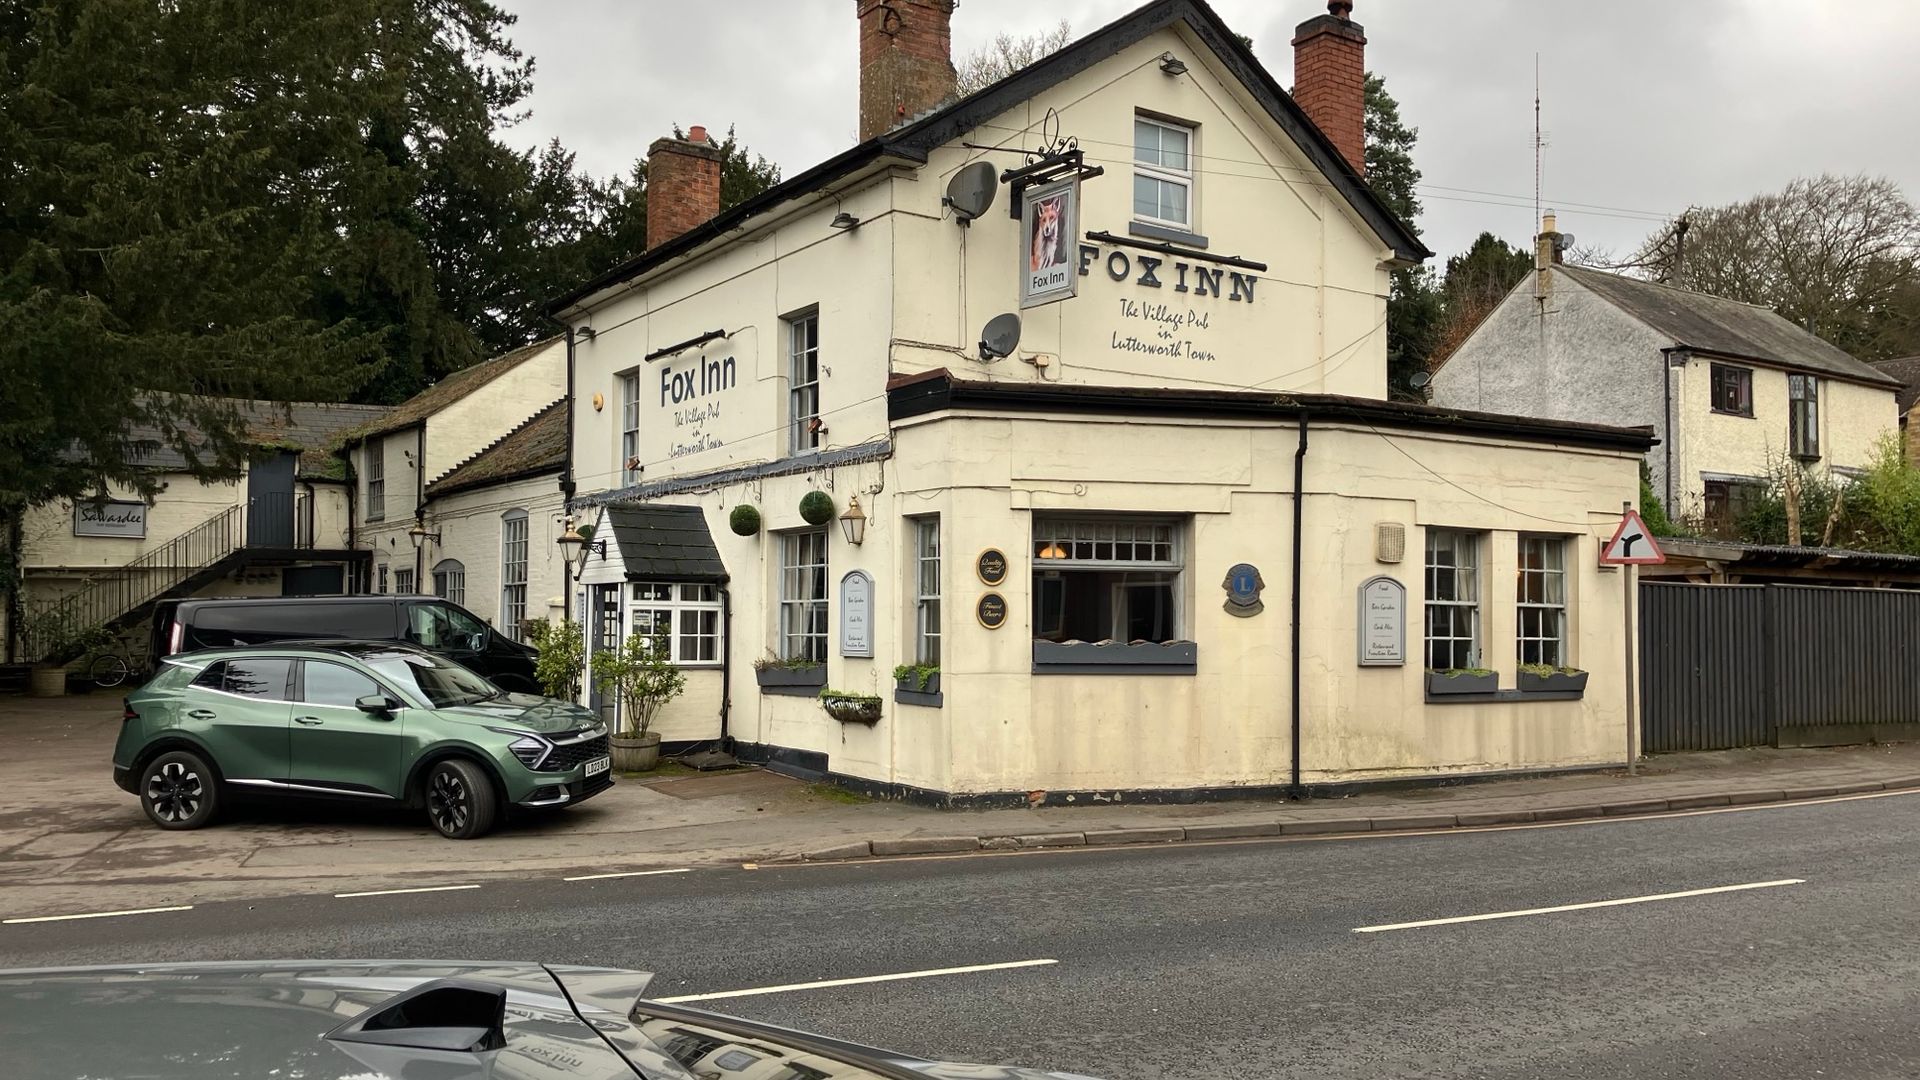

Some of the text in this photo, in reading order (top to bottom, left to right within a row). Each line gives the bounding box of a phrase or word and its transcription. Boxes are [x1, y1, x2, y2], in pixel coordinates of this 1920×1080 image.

[1032, 271, 1065, 289] Fox Inn
[1079, 245, 1257, 303] FOX INN
[1120, 299, 1209, 331] The Village Pub
[1158, 326, 1173, 339] in
[1112, 331, 1216, 361] Lutterworth Town
[661, 355, 735, 408] Fox Inn
[674, 400, 720, 428] The Village Pub
[706, 433, 723, 450] Town
[981, 558, 1003, 567] Quality
[1239, 576, 1251, 591] L
